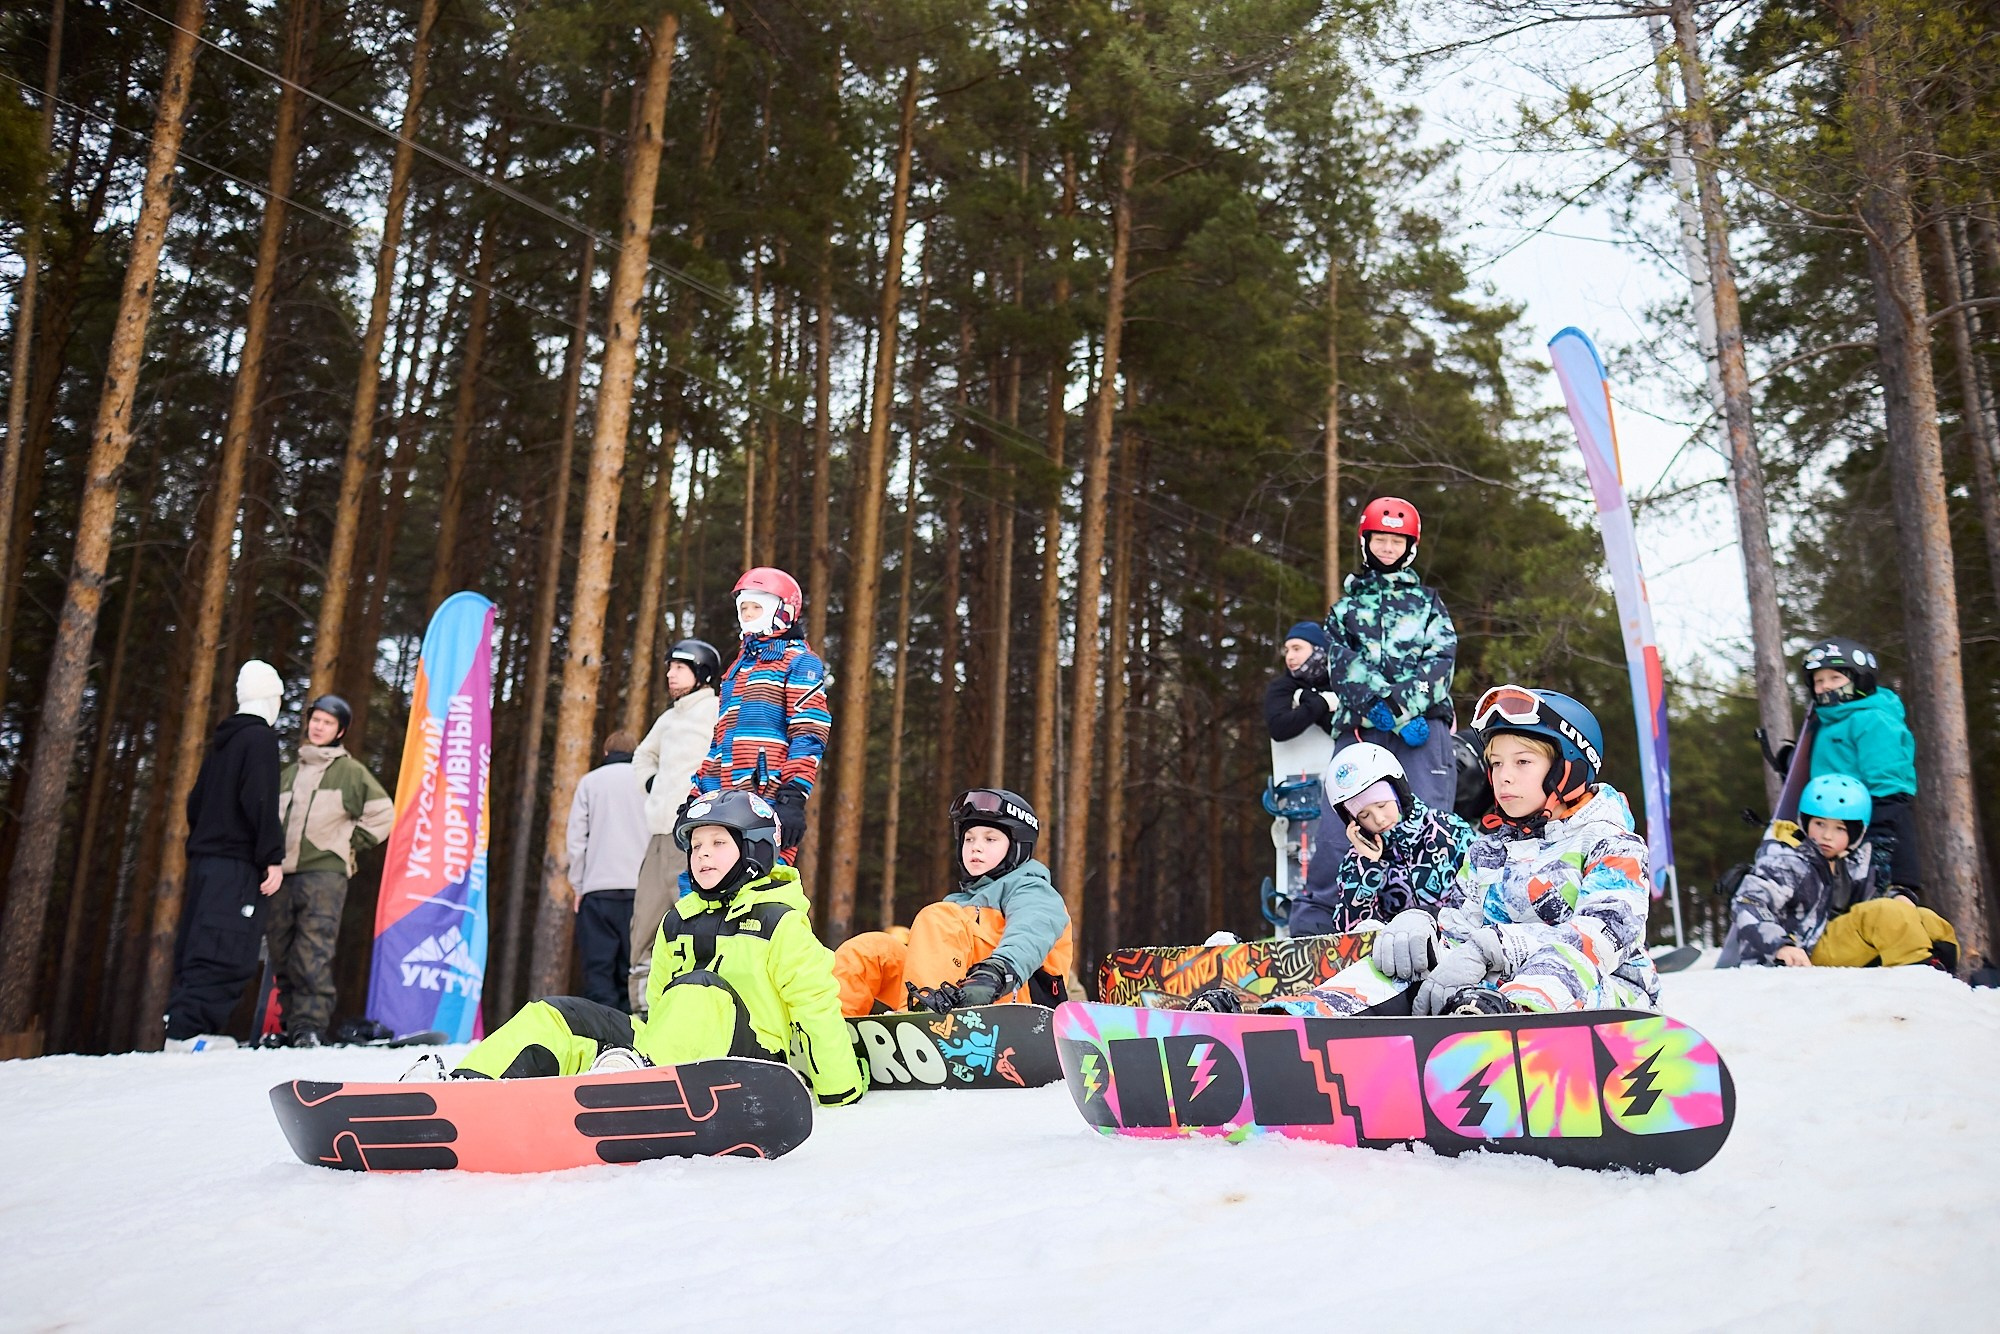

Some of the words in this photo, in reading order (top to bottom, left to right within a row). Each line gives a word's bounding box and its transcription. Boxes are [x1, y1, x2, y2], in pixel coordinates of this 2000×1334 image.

[405, 716, 446, 879] УКТУССКИЙ
[443, 694, 474, 885] СПОРТИВНЫЙ
[1559, 719, 1602, 775] uvex
[1006, 802, 1039, 830] uvex
